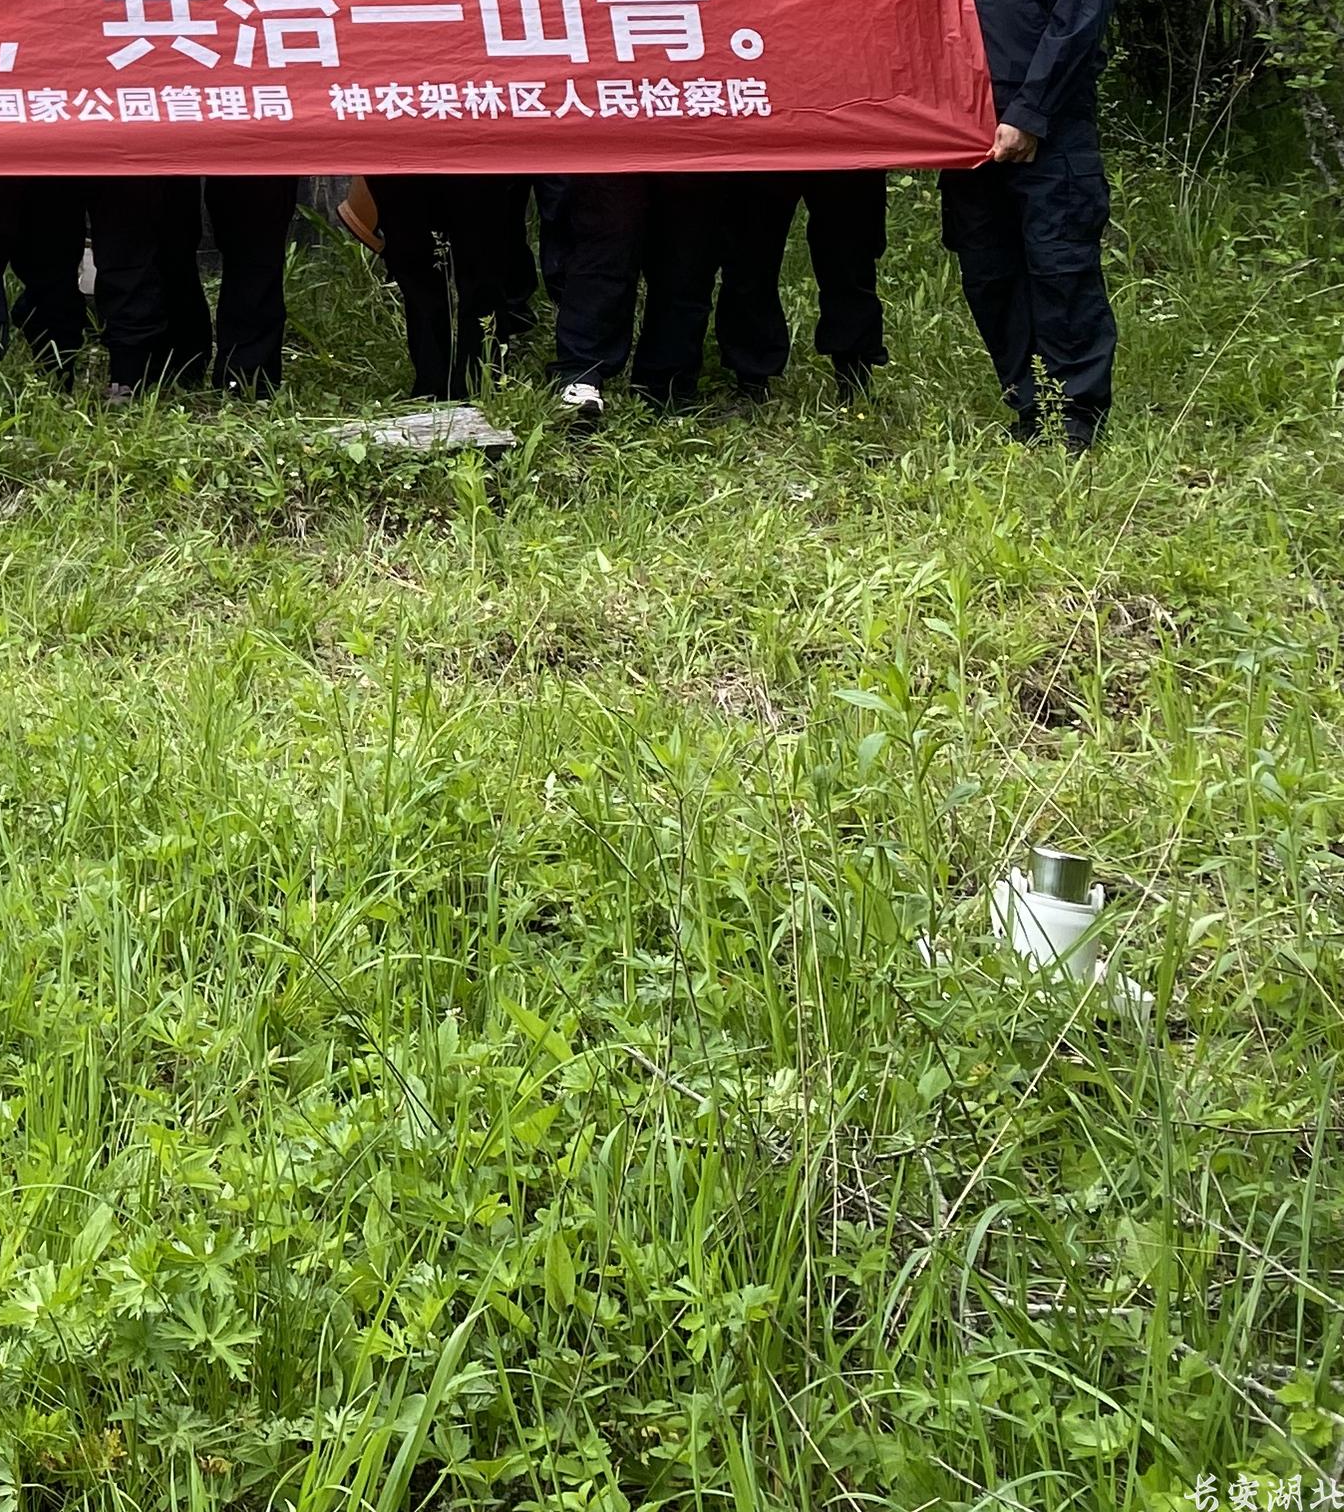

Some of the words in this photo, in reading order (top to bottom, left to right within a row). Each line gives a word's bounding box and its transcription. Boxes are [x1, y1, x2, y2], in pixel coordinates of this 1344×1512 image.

[328, 77, 772, 120] 神农架林区人民检察院
